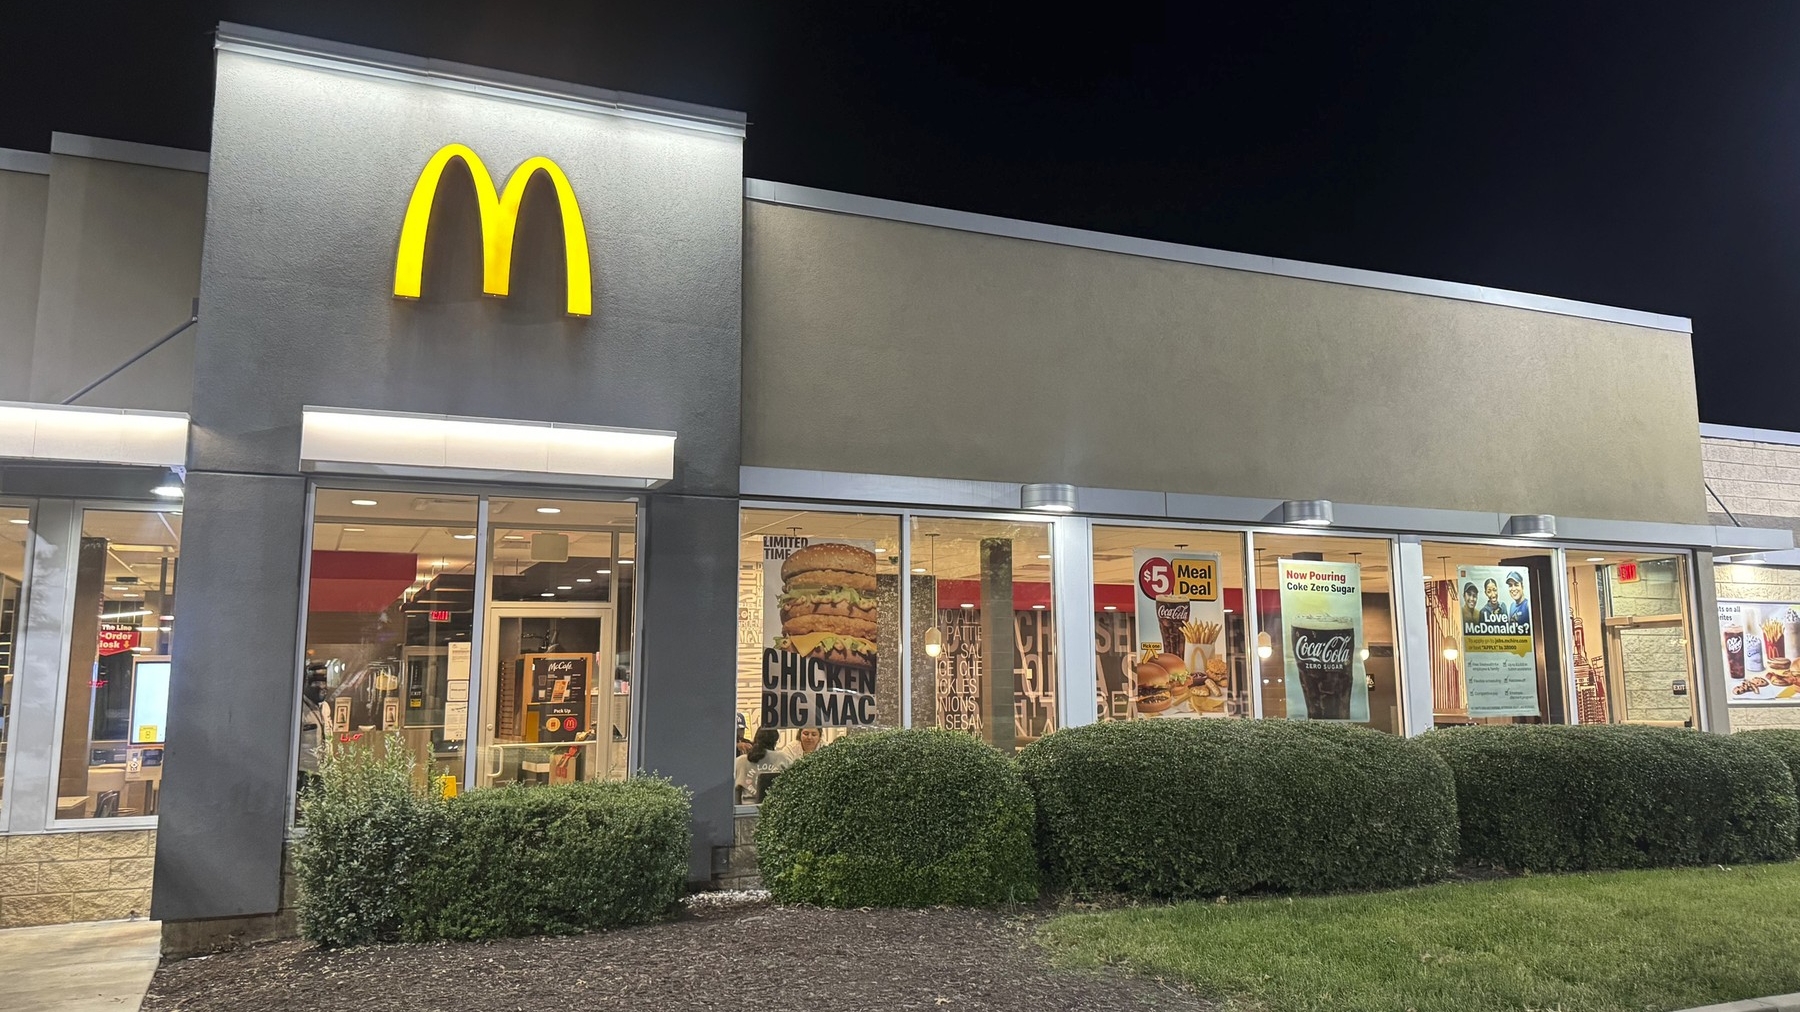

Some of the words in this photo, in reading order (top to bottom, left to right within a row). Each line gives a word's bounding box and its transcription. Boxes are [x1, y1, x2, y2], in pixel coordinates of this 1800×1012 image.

[763, 536, 809, 548] LIMITED
[764, 548, 791, 560] TIME
[1143, 565, 1169, 593] $5
[1177, 565, 1211, 579] Meal
[1286, 570, 1308, 580] Now
[1309, 571, 1346, 584] Pouring
[1180, 581, 1211, 595] Deal
[1286, 582, 1309, 591] Coke
[1310, 583, 1329, 592] Zero
[1331, 584, 1355, 595] Sugar
[1484, 611, 1508, 622] Love
[1465, 622, 1530, 634] McDonald's?
[762, 647, 877, 694] CHICKEN
[761, 691, 808, 729] BIG
[815, 693, 876, 726] MAC
